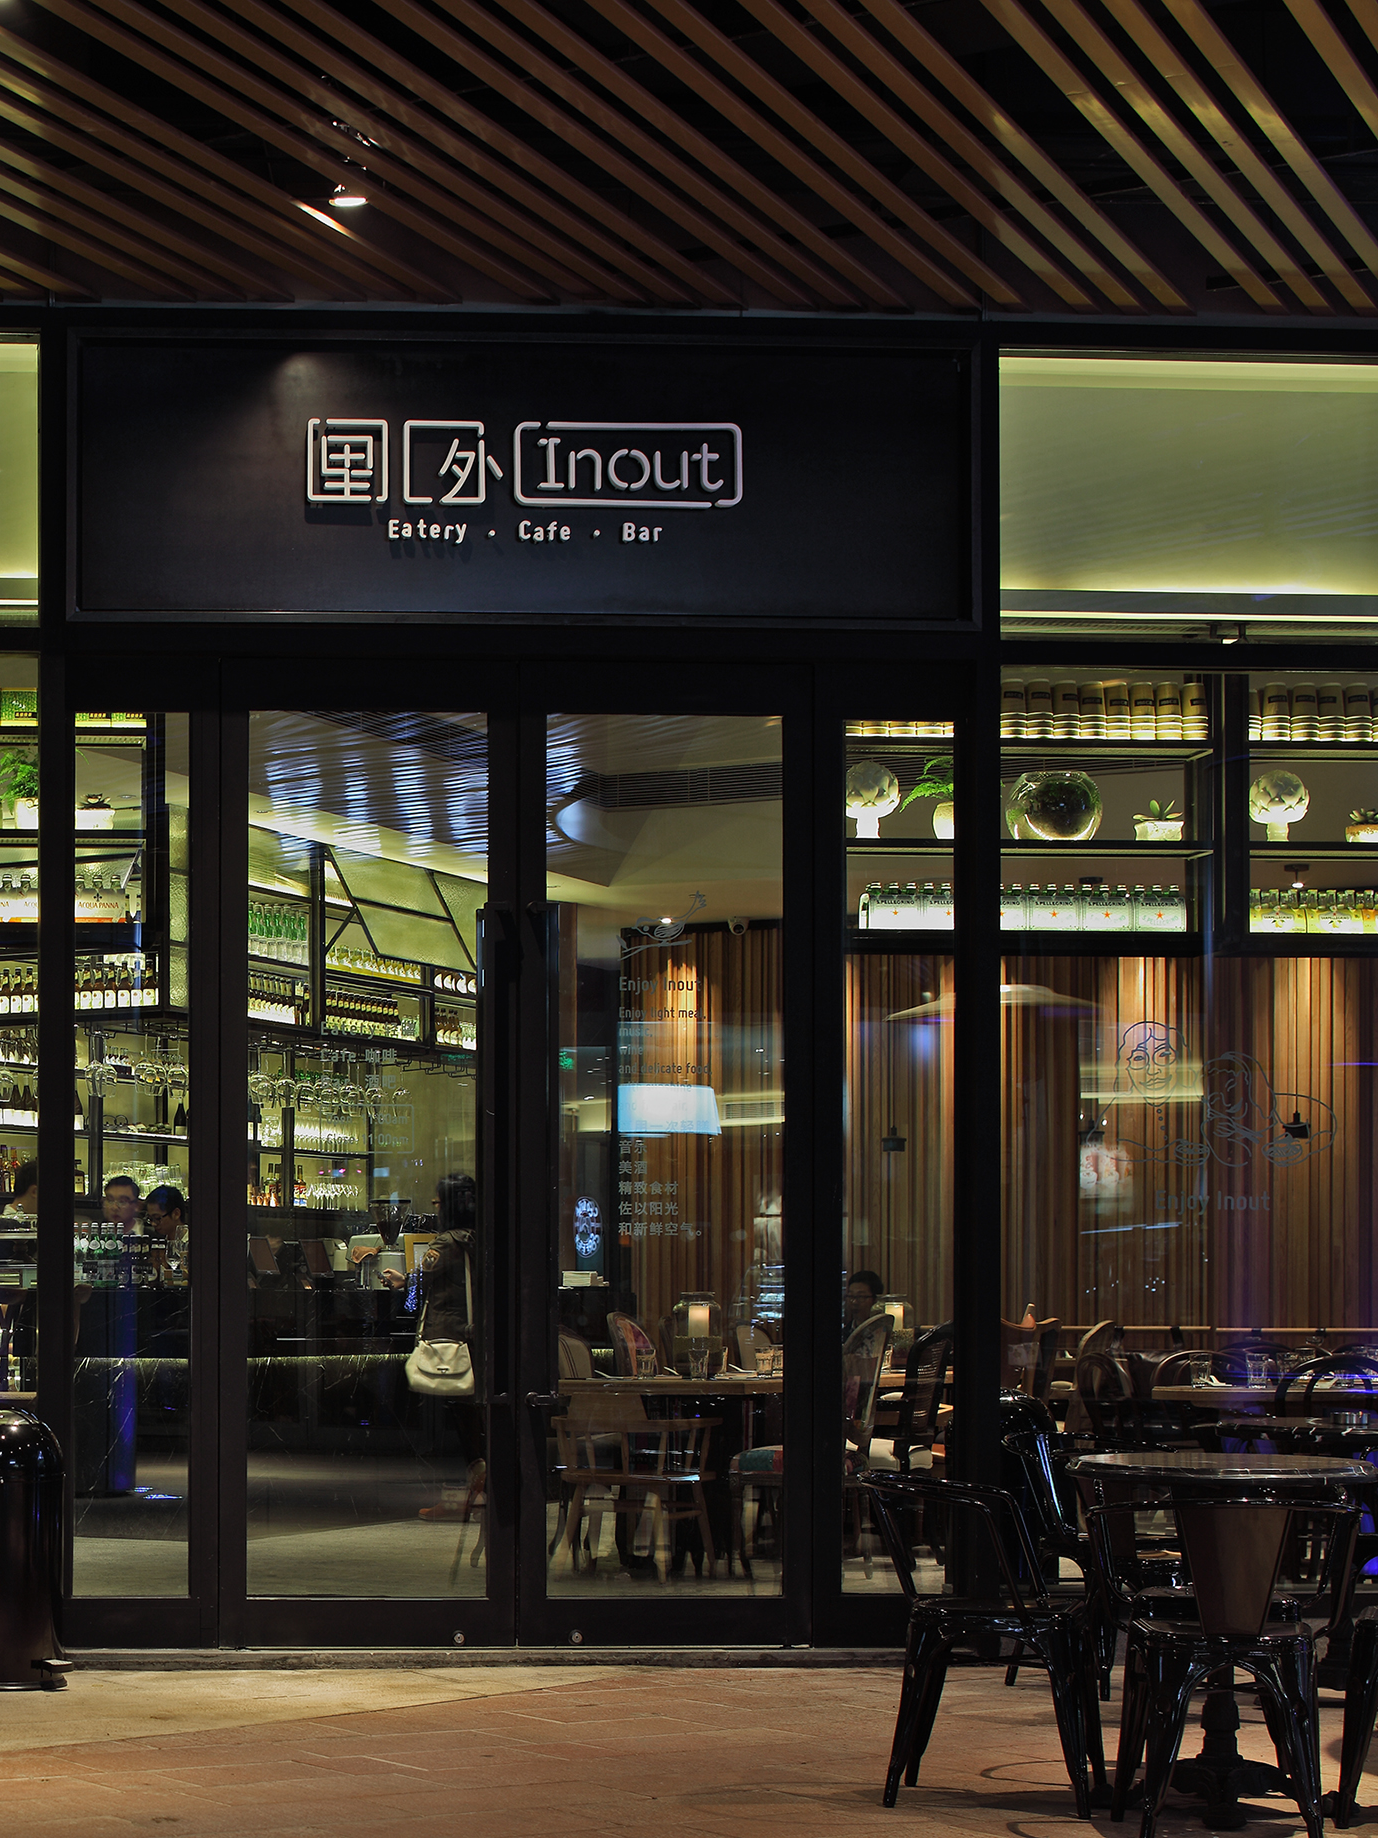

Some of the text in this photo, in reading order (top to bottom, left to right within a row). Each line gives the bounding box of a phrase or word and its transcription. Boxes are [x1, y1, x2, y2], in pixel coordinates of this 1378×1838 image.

[537, 437, 724, 492] Inout
[387, 519, 662, 544] Eatery Cafe Bar
[618, 976, 702, 995] Enjoy Inout
[618, 1007, 647, 1020] Enjoy
[650, 1007, 675, 1020] light
[320, 1047, 398, 1063] Cafe 咖啡
[618, 1063, 638, 1074] and
[641, 1063, 682, 1075] delicate
[365, 1075, 397, 1089] 酒吧
[618, 1140, 647, 1154] 音乐
[618, 1160, 648, 1175] 美酒
[618, 1181, 679, 1196] 精致食材
[618, 1201, 679, 1216] 佐以阳光
[1156, 1190, 1270, 1215] Enjoy Inout
